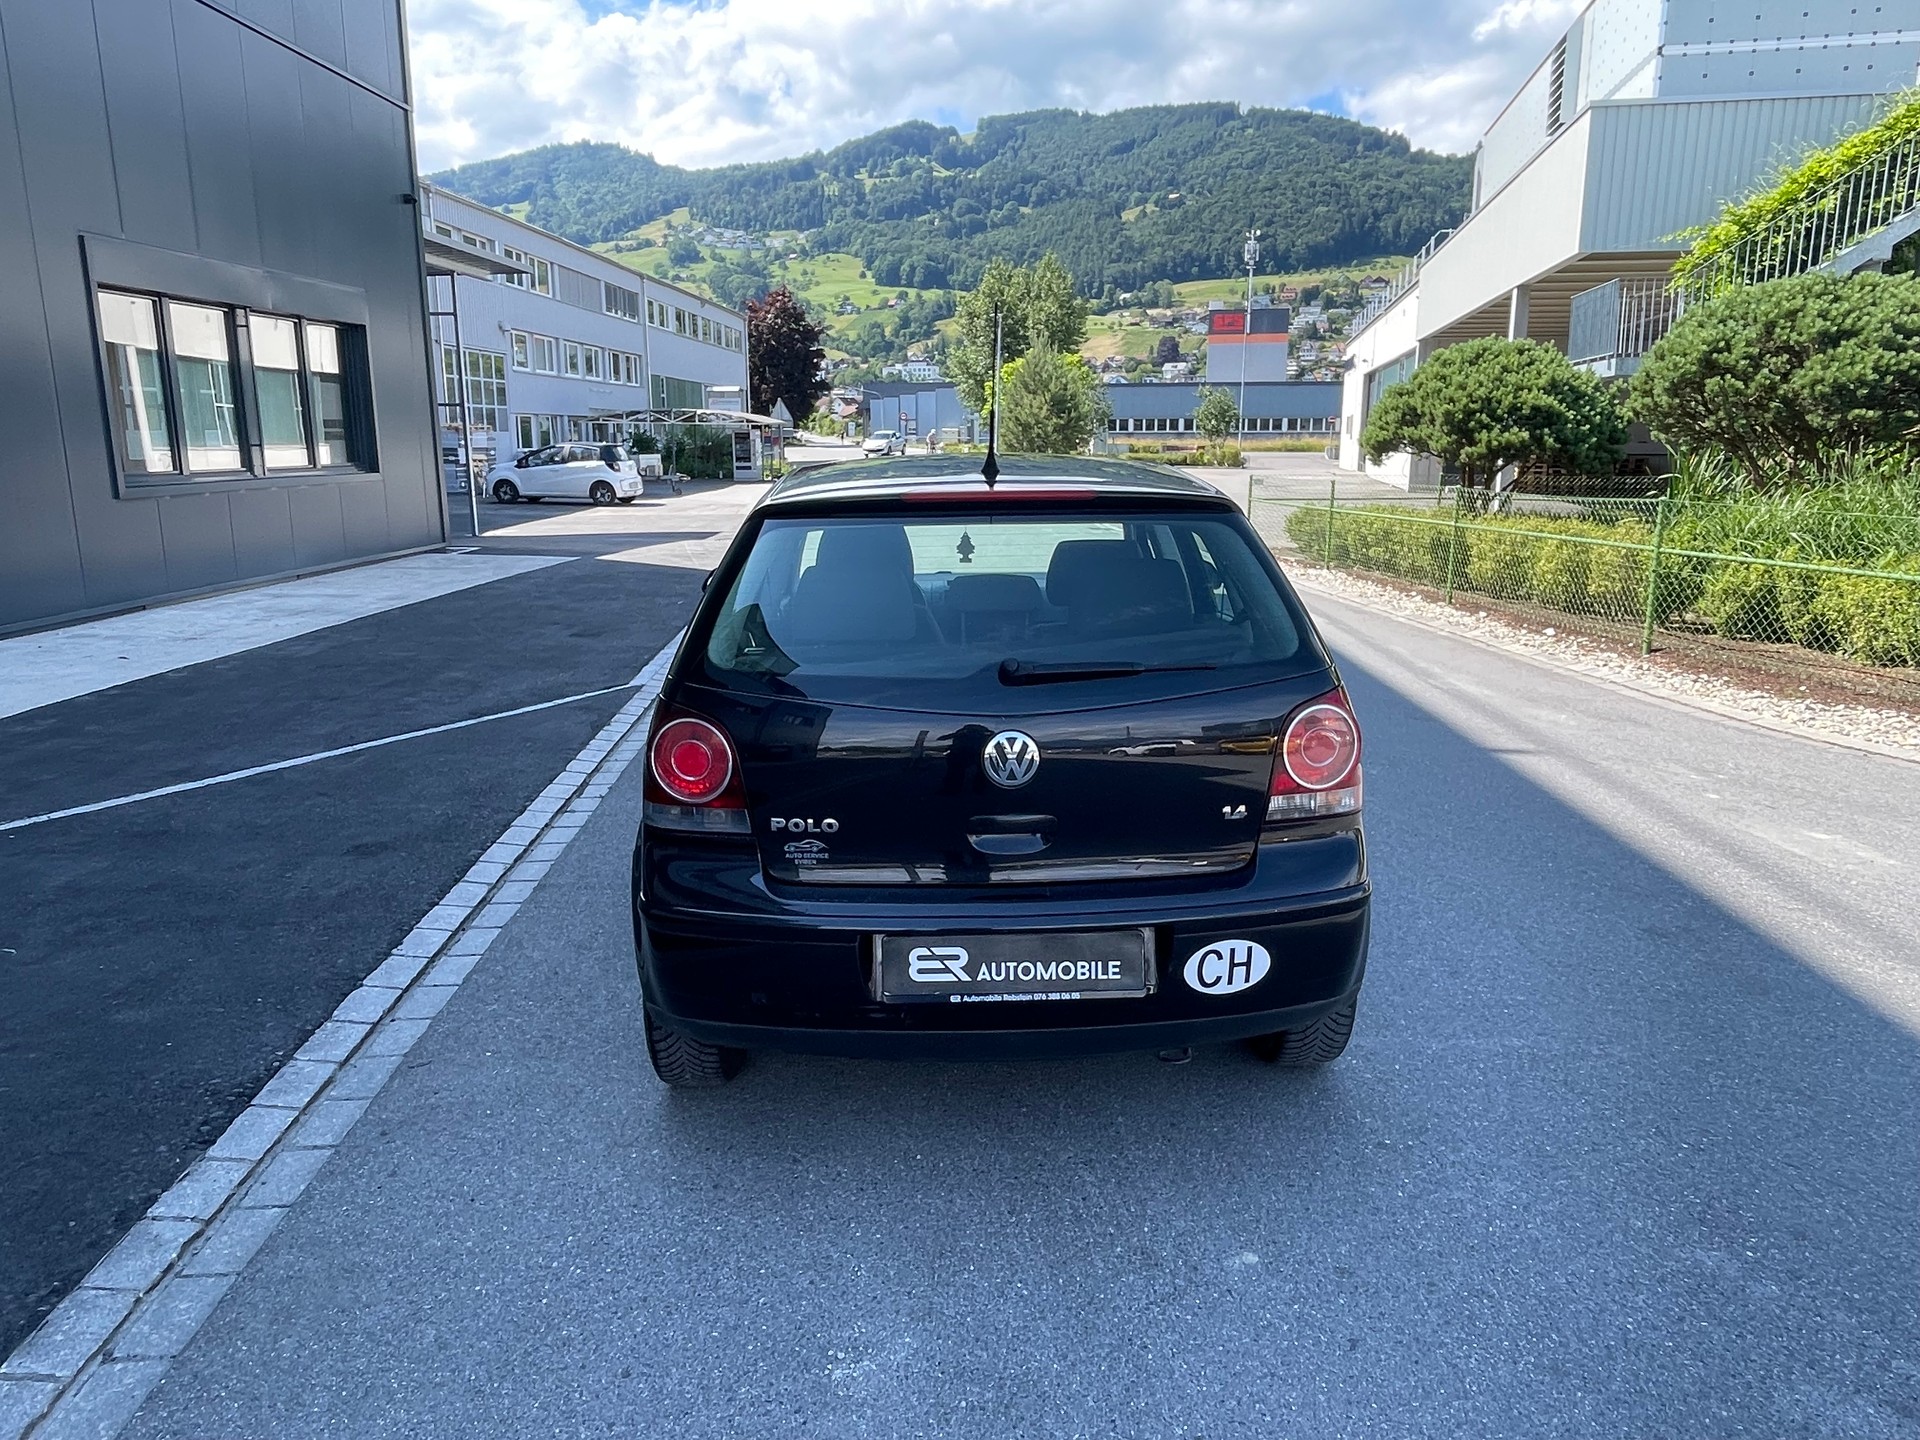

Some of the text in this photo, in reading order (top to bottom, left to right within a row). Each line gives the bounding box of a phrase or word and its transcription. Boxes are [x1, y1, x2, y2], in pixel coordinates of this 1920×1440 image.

[984, 731, 1039, 785] VW
[770, 817, 839, 833] POLO
[976, 960, 1122, 982] AUTOMOBILE
[1197, 946, 1253, 988] CH
[963, 994, 1002, 1002] Automobile
